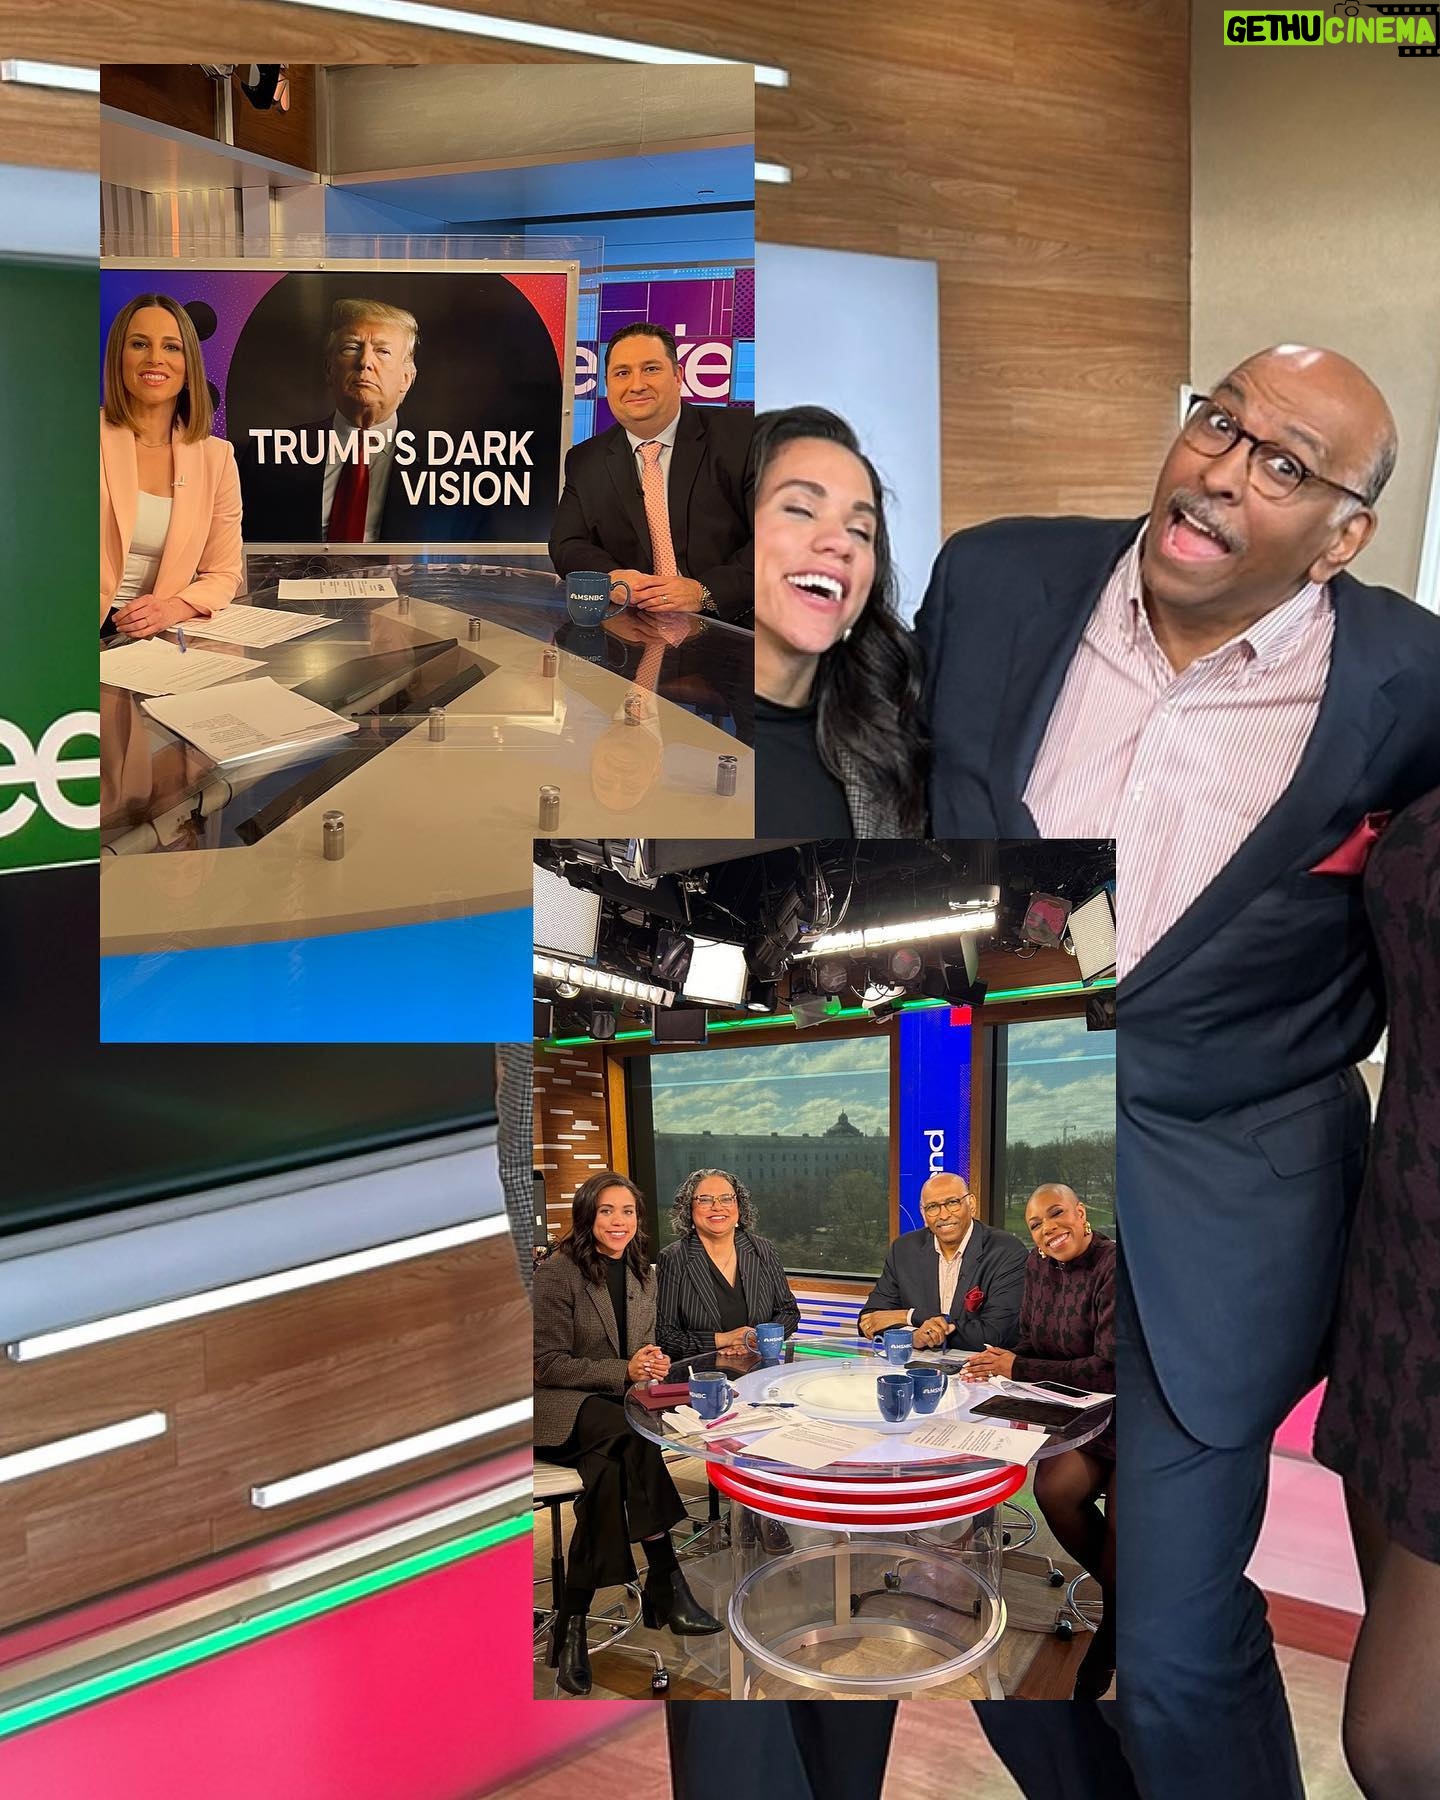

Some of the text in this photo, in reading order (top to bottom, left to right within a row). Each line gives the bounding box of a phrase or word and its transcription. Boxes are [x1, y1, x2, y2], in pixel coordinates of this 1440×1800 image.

[248, 428, 535, 466] TRUMP'S DARK
[400, 471, 531, 506] VISION
[924, 1130, 945, 1178] nd
